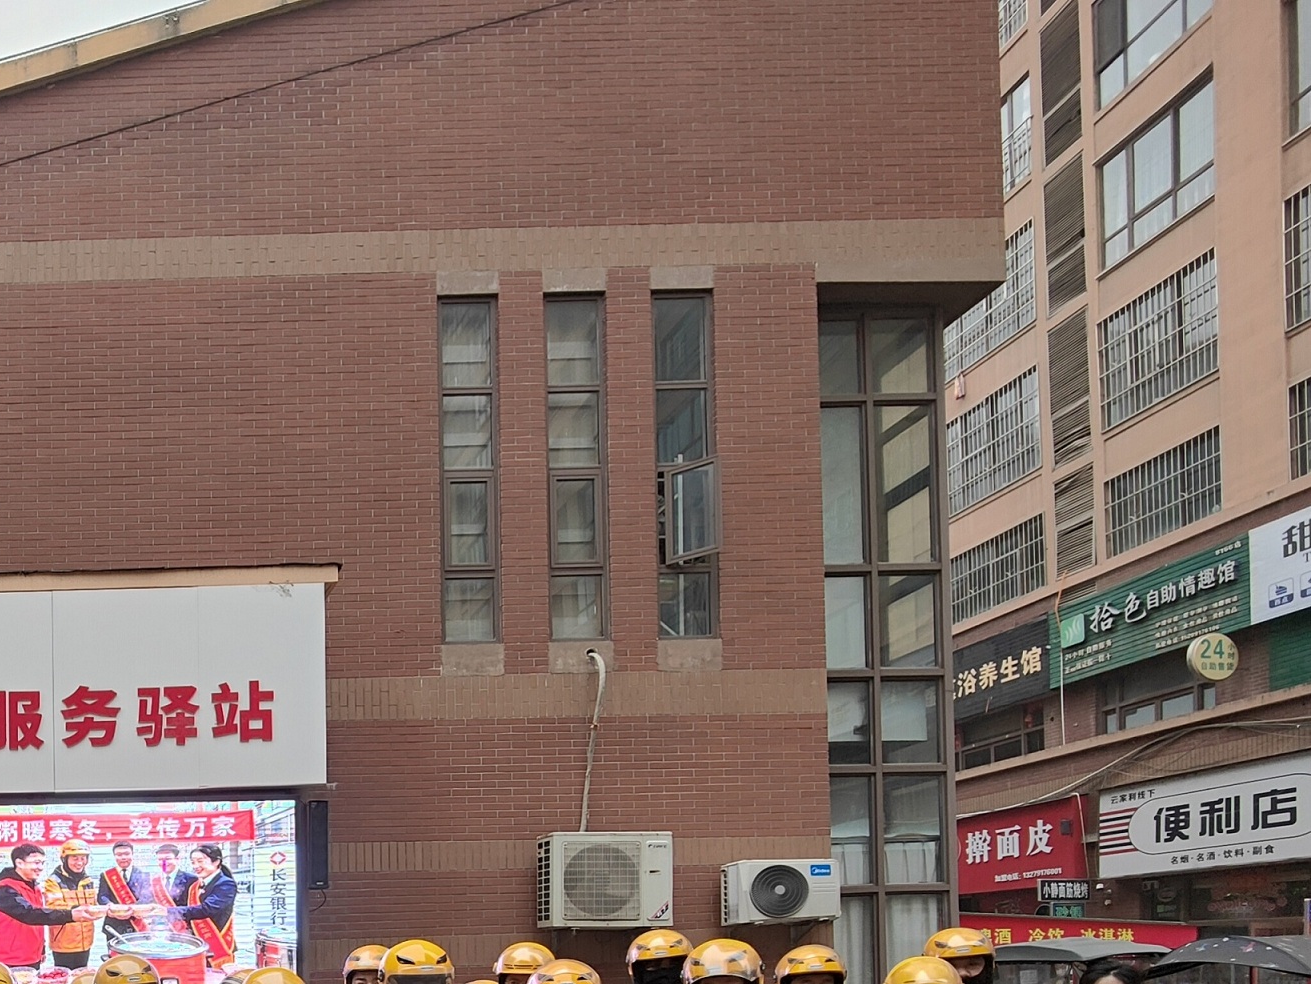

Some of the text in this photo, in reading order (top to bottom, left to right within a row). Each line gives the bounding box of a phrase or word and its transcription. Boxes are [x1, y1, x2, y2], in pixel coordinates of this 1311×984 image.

[1088, 559, 1236, 635] 拾色自助情趣馆
[954, 646, 1042, 700] 浴养生馆
[1200, 639, 1225, 659] 24
[1153, 787, 1298, 844] 便利店
[269, 868, 288, 926] 长安银行
